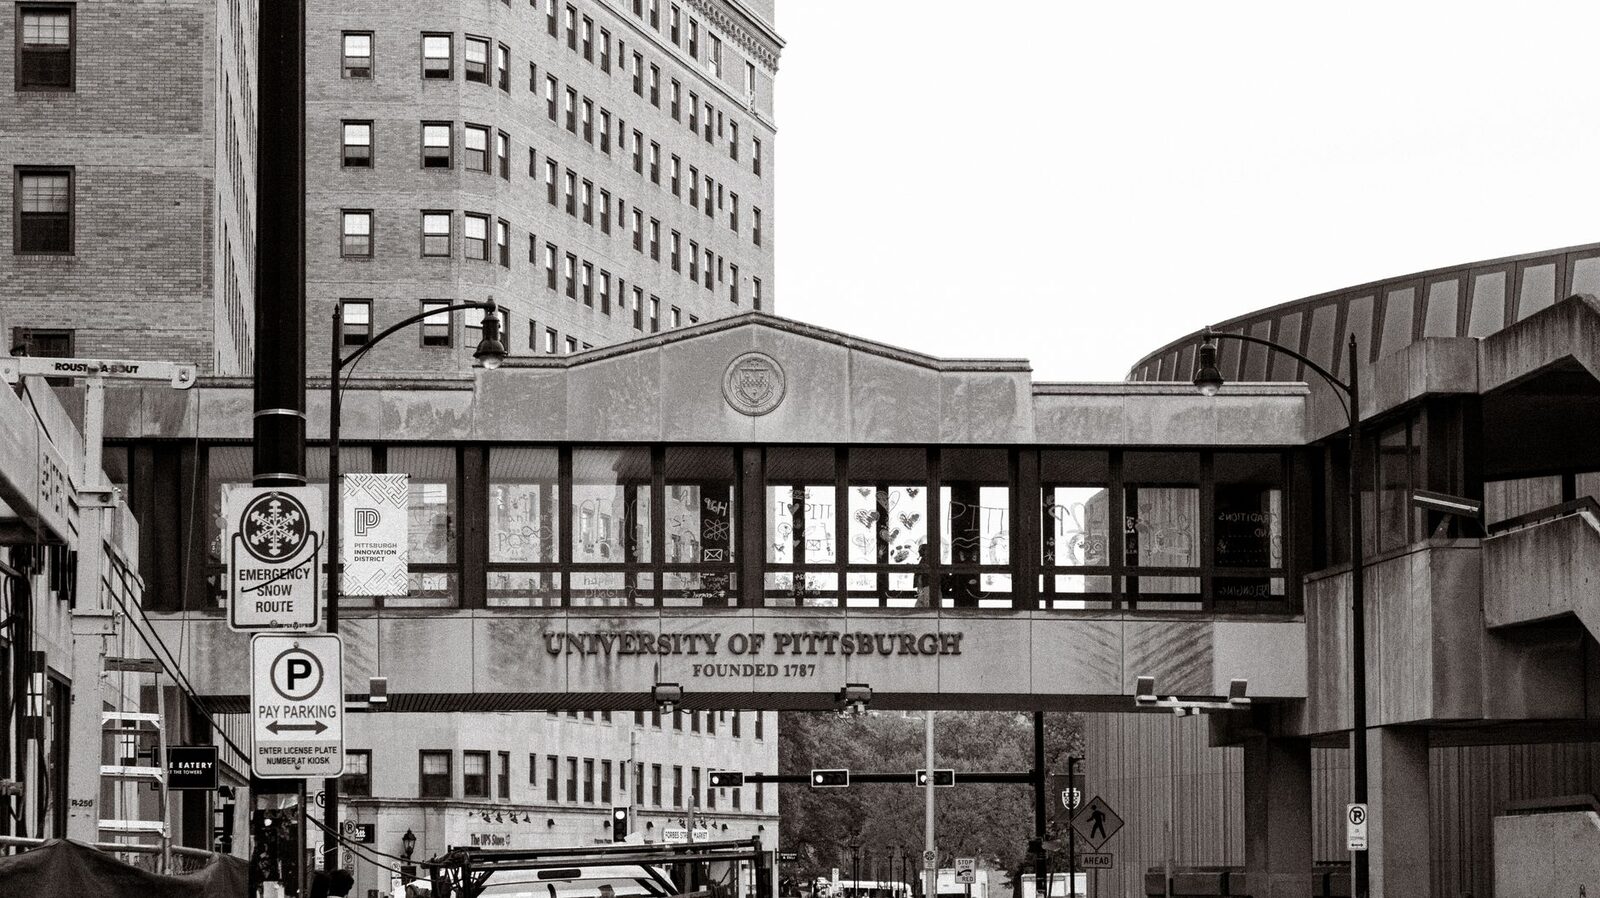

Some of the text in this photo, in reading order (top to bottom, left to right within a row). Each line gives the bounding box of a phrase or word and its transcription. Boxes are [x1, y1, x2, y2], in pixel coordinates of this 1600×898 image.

[239, 568, 310, 580] EMERGENCY
[257, 585, 292, 596] SNOW
[256, 601, 293, 613] ROUTE
[543, 632, 964, 656] UNIVERSITY OF PITTSBURGH
[692, 664, 815, 677] FOUNDED 1787
[259, 705, 337, 718] PAY PARKING
[72, 799, 93, 807] R-250
[470, 833, 480, 846] The
[481, 833, 491, 846] UPS
[1083, 856, 1109, 865] AHEAD
